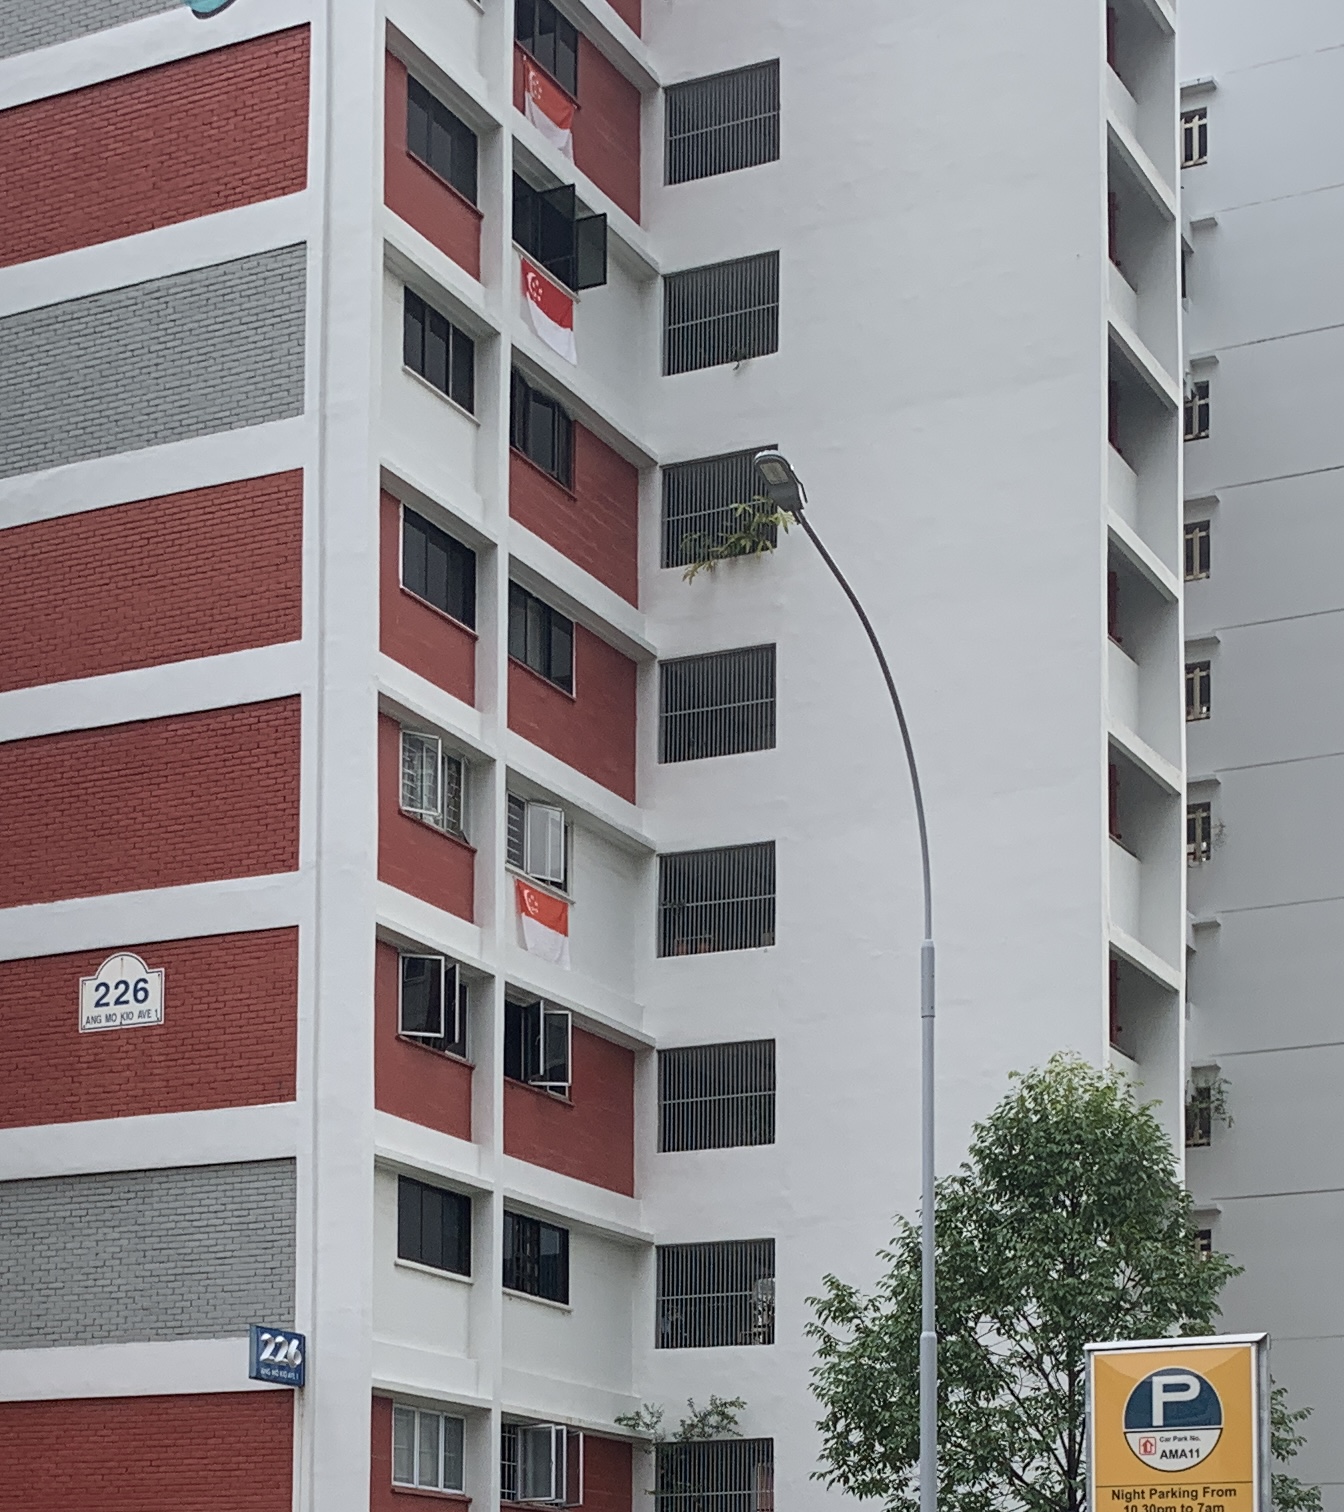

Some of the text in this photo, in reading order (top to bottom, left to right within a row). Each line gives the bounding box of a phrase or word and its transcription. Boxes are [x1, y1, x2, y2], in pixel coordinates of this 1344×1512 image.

[94, 978, 149, 1008] 226
[85, 1014, 102, 1025] ANG
[105, 1013, 117, 1022] MO
[120, 1011, 134, 1021] KIO
[137, 1010, 151, 1019] AVE
[259, 1333, 302, 1368] 226
[1152, 1374, 1201, 1426] P
[1160, 1448, 1200, 1460] AMA11
[1111, 1487, 1237, 1502] Night Parking From
[1197, 1503, 1224, 1512] 7am
